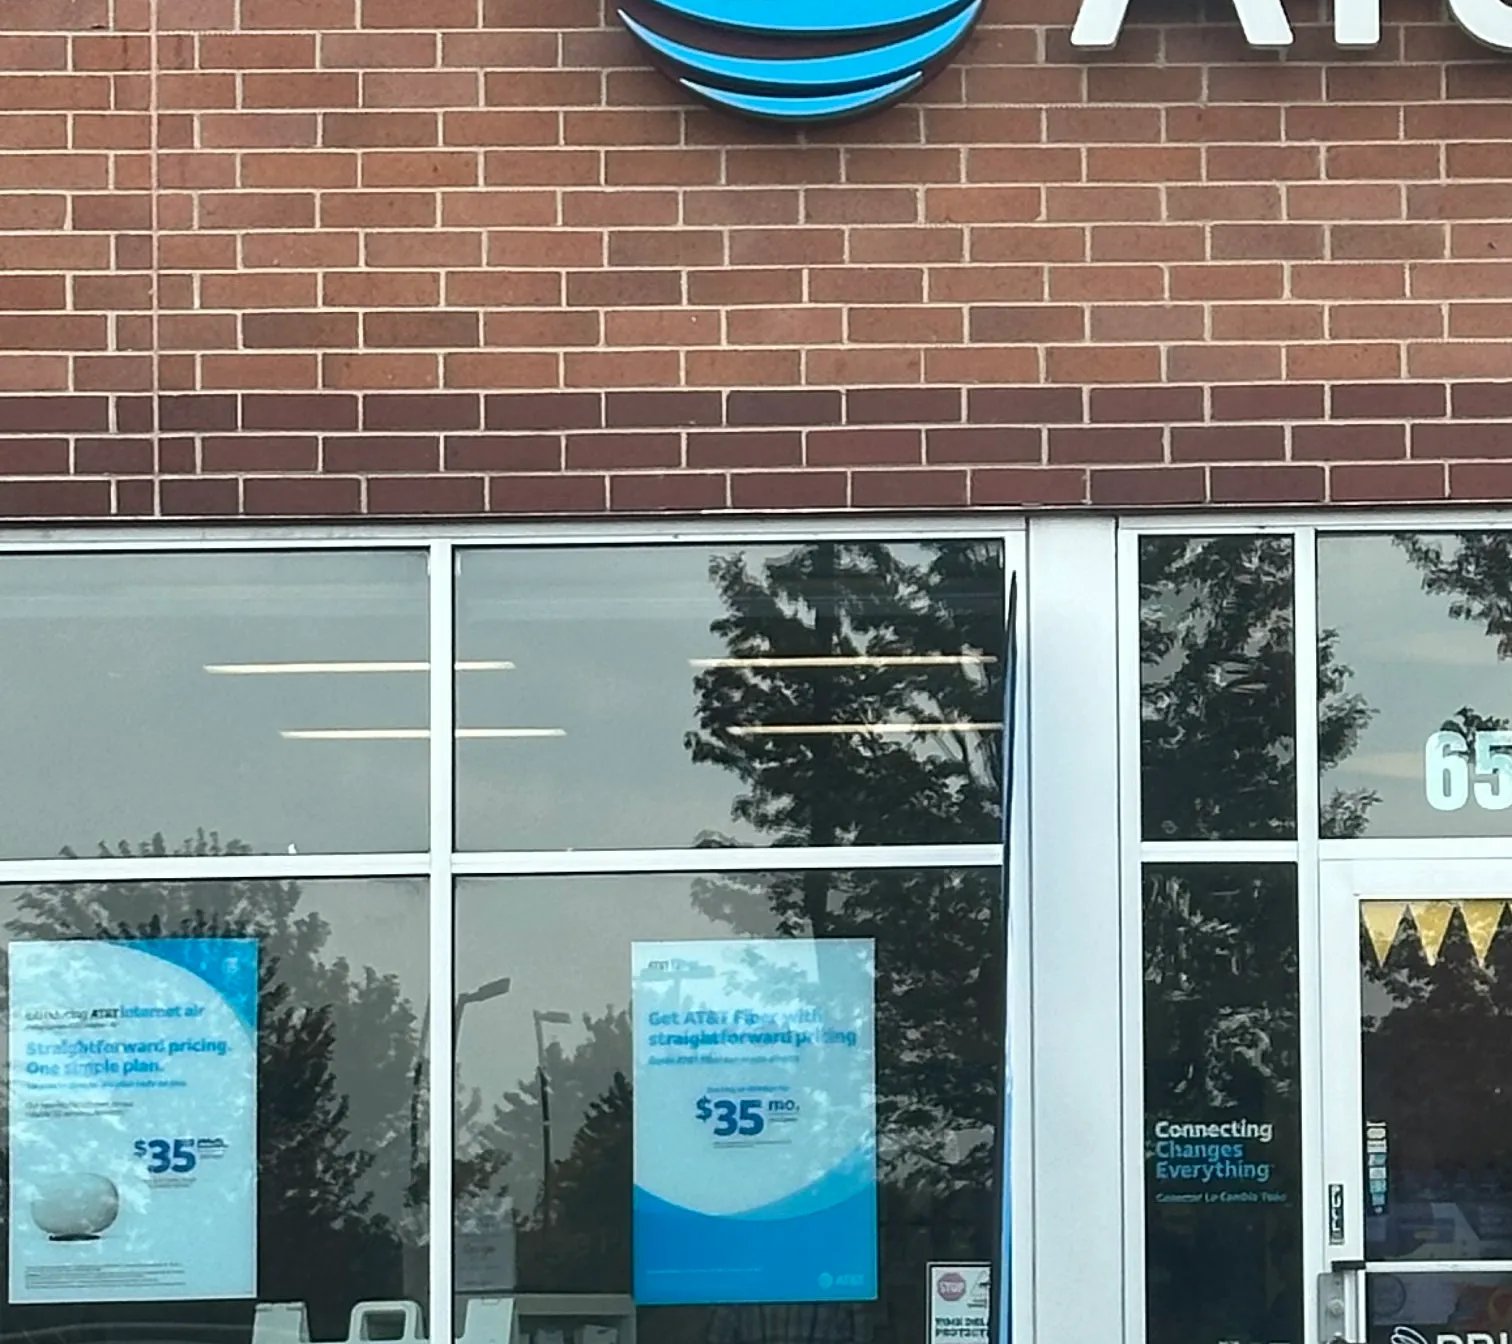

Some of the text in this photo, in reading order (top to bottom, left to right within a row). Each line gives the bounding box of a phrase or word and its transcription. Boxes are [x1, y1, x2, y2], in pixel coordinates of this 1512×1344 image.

[648, 1010, 680, 1025] Get
[26, 1061, 60, 1075] One
[123, 1058, 166, 1076] plan.
[695, 1094, 765, 1137] $35
[1154, 1117, 1273, 1143] Connecting
[133, 1138, 197, 1174] $35
[1155, 1140, 1244, 1163] Changes
[1156, 1159, 1270, 1183] Everything
